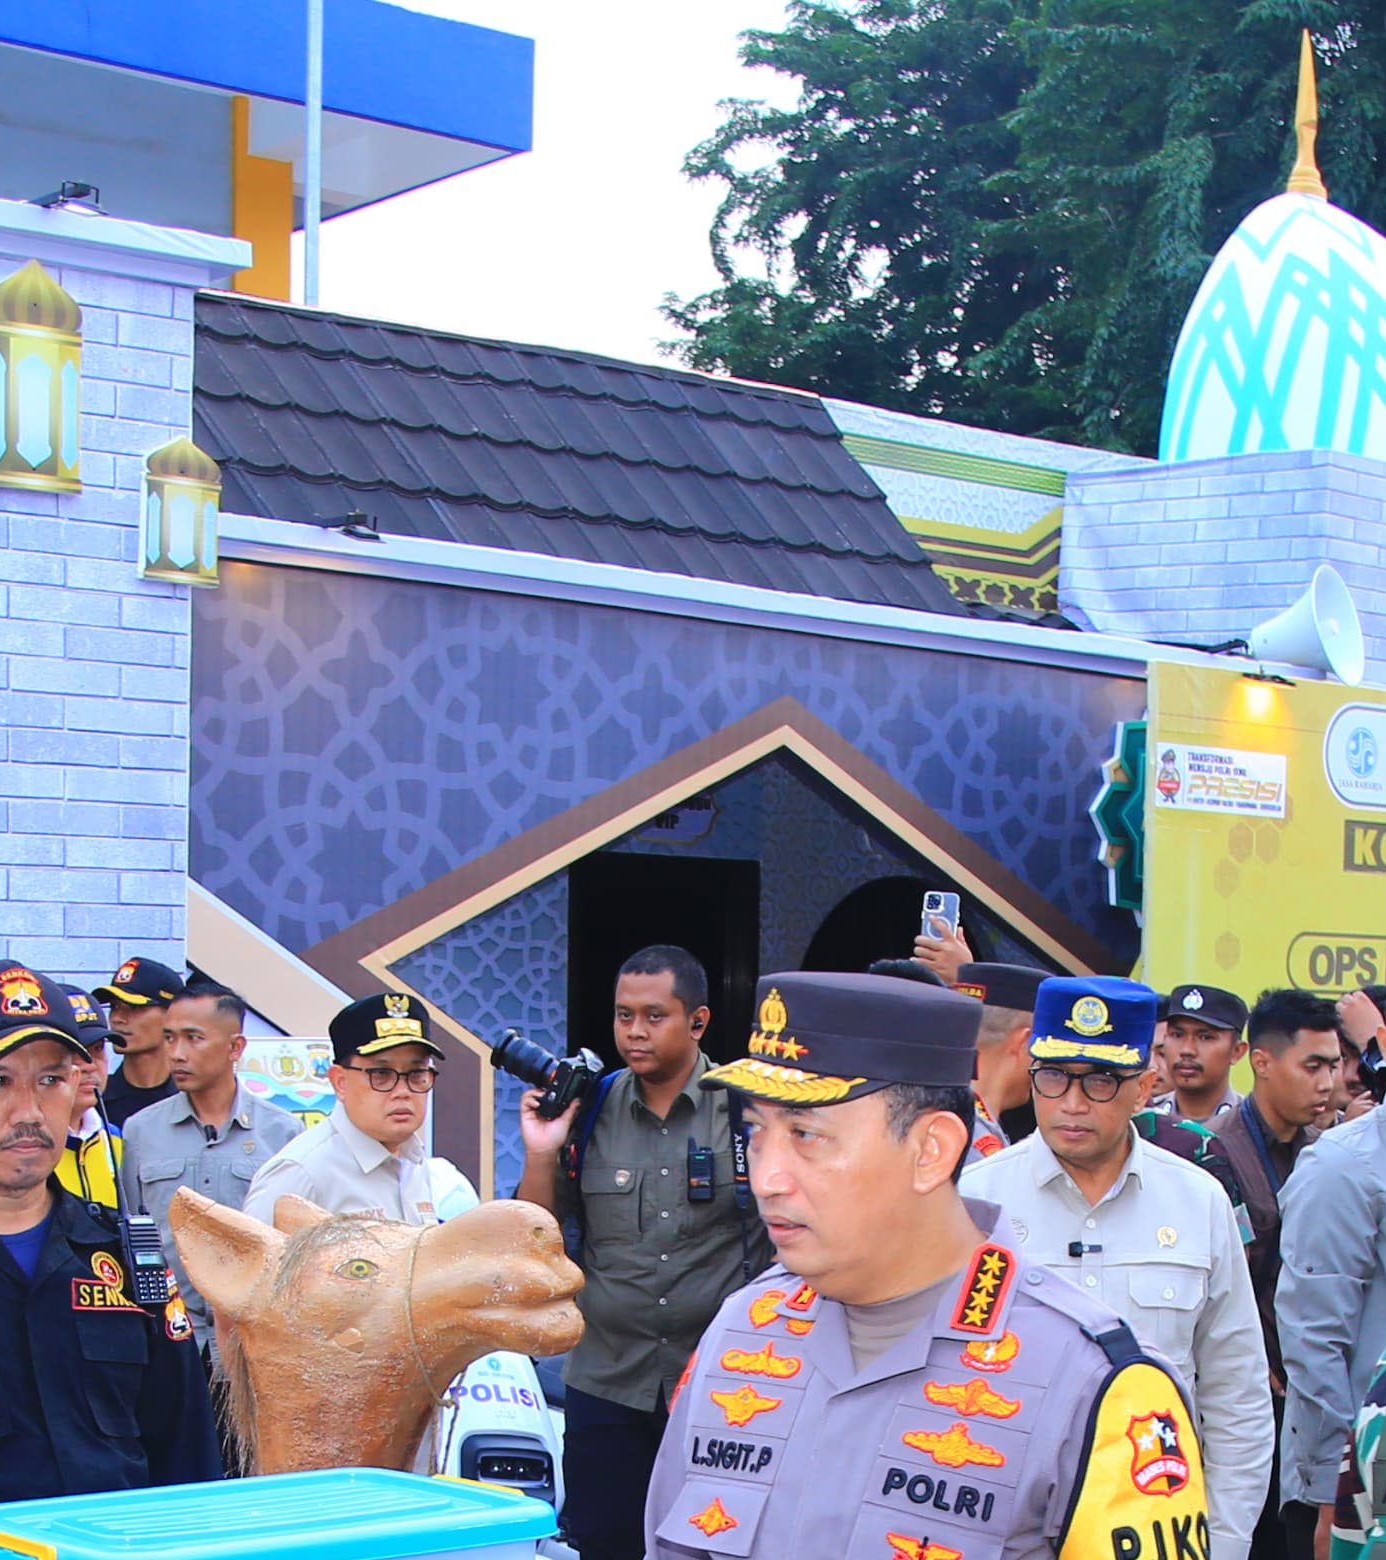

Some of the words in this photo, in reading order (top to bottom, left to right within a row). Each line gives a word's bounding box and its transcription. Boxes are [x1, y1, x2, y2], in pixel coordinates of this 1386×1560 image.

[1187, 774, 1282, 803] PRESISI
[1310, 945, 1378, 987] OPS
[734, 1133, 746, 1173] SONY
[449, 1383, 542, 1411] POLISI
[691, 1436, 773, 1474] L.SIGIT.P
[882, 1467, 995, 1522] POLRI
